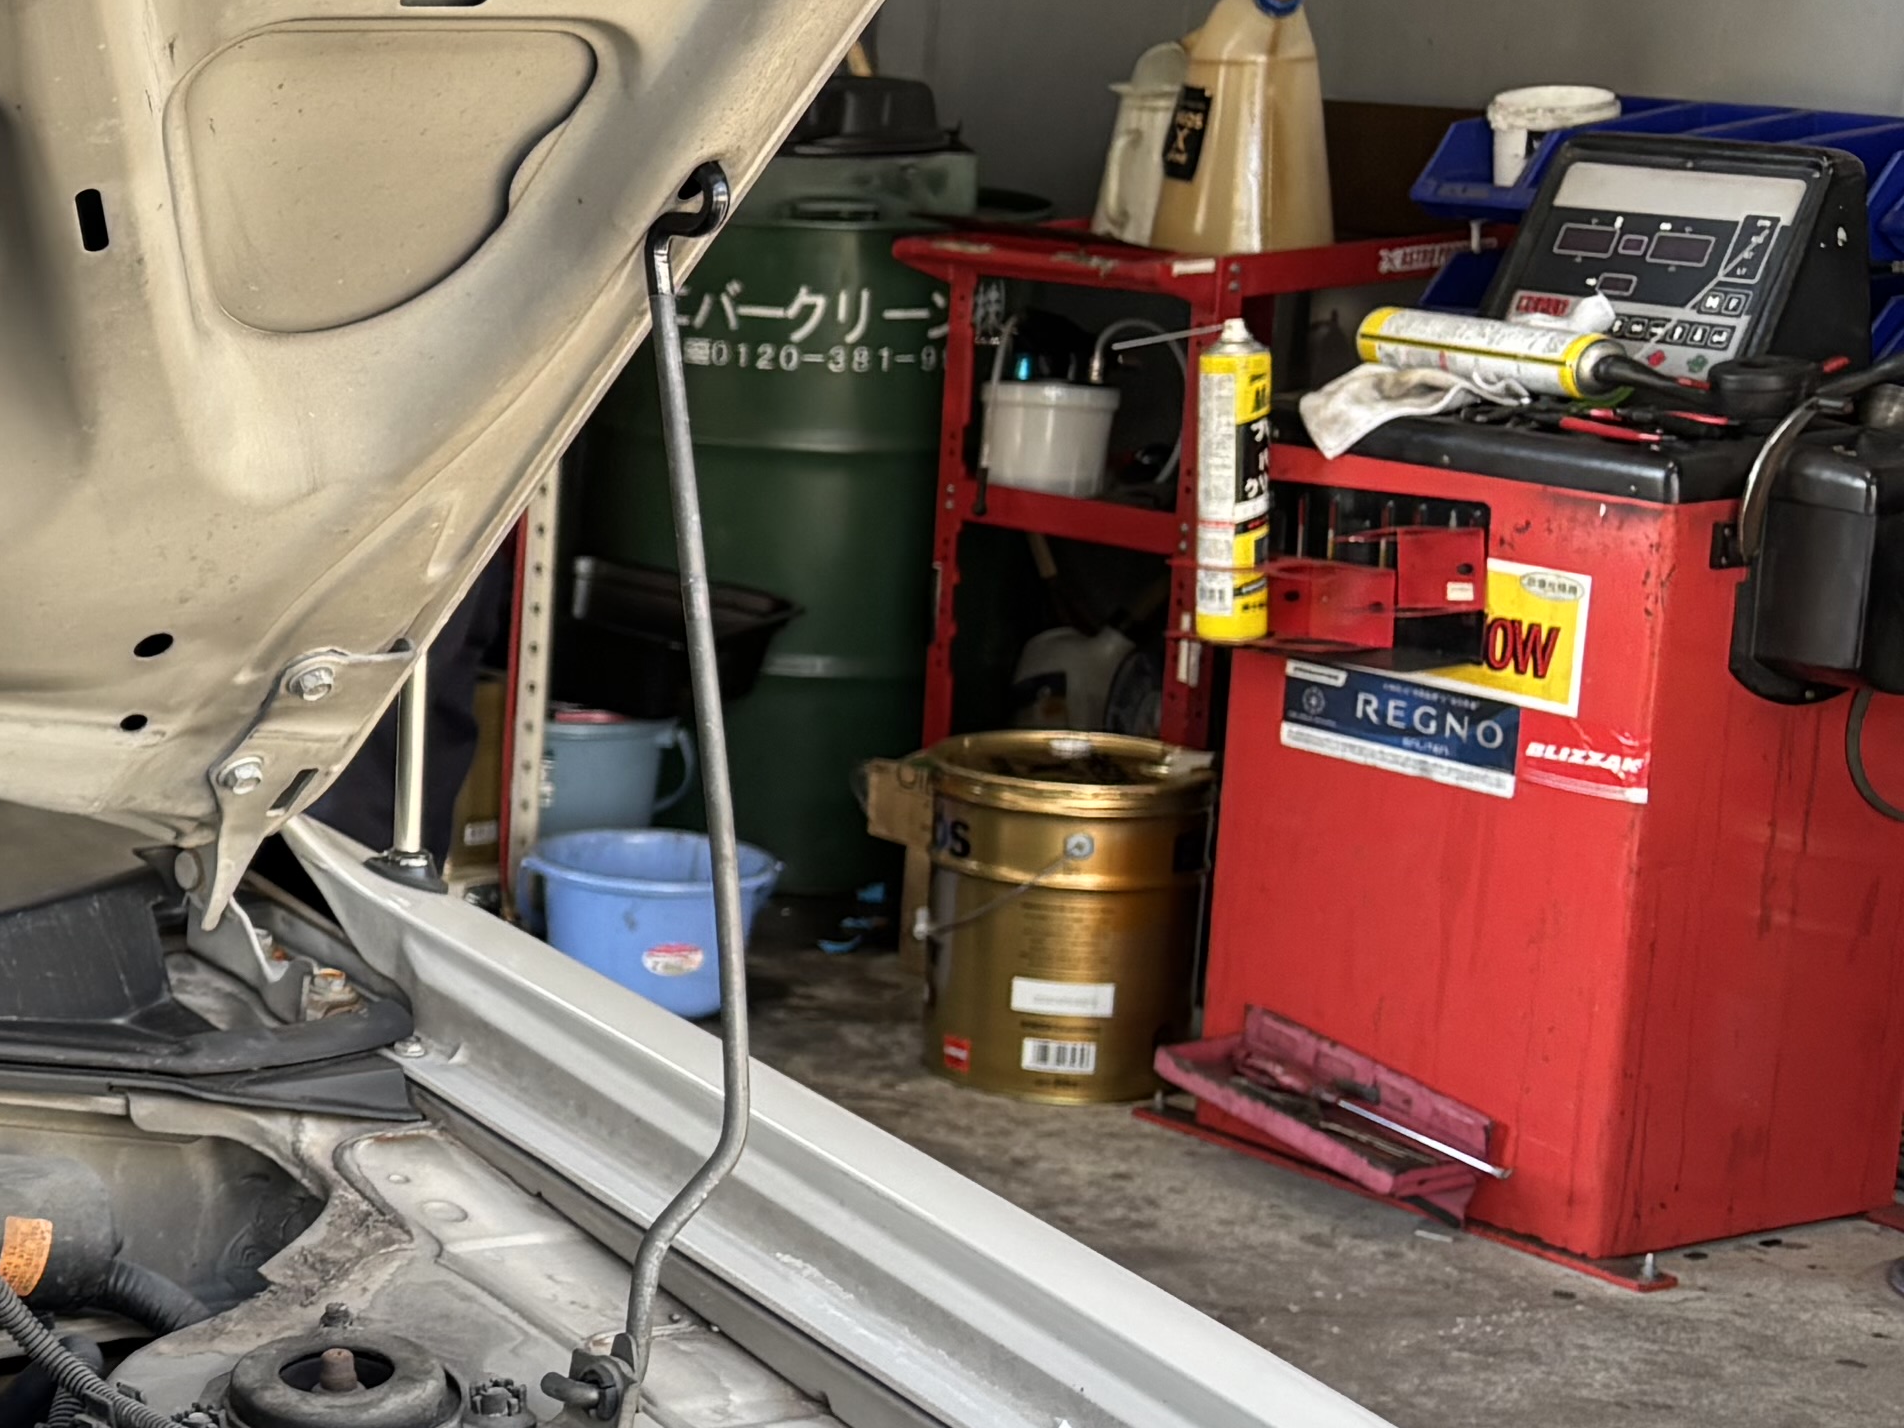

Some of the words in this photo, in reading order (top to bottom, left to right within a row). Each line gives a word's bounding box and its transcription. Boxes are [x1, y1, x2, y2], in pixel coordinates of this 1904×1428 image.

[712, 342, 947, 372] 0120-381-9
[1483, 617, 1560, 678] OW
[1356, 692, 1504, 749] REGNO
[1525, 741, 1644, 779] BLIZZAK
